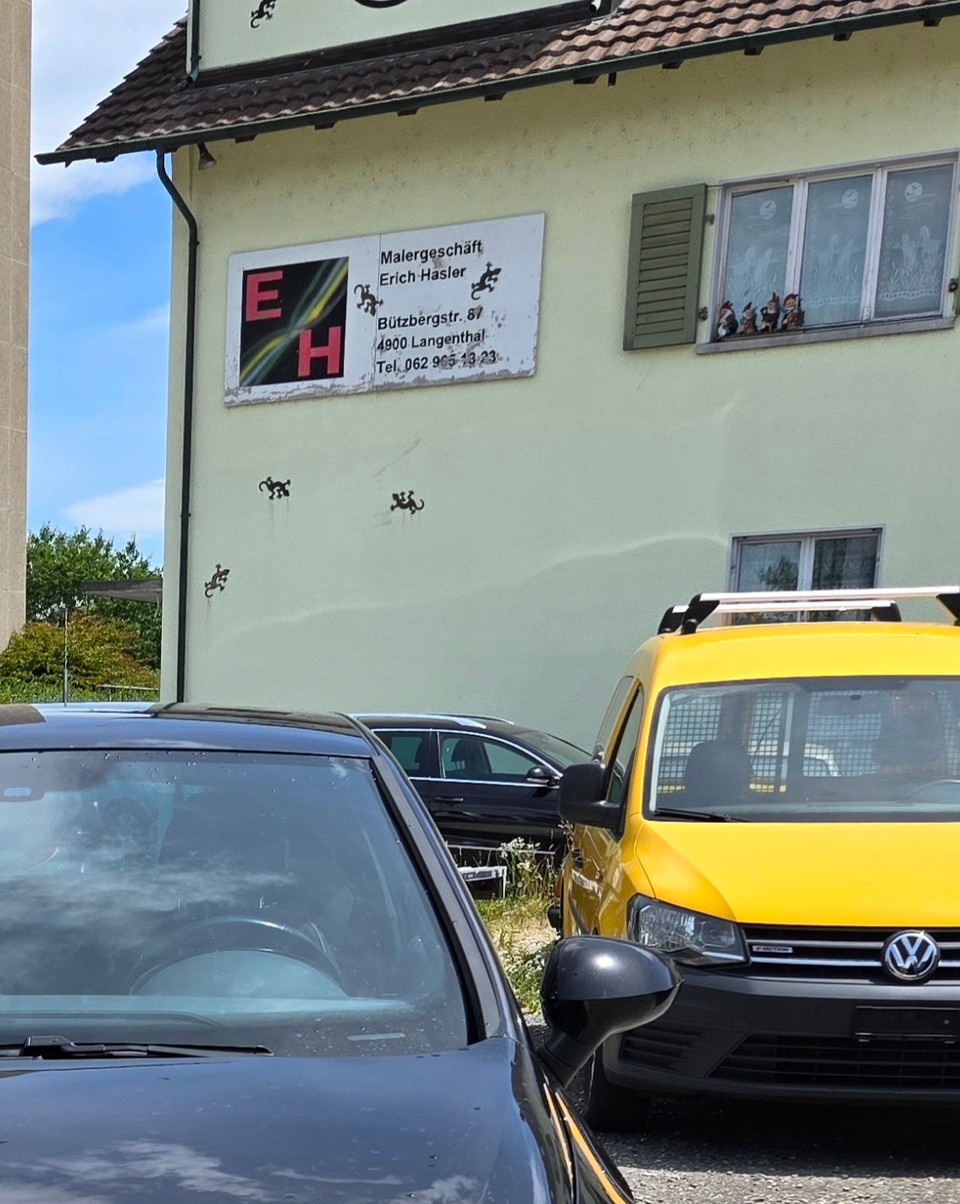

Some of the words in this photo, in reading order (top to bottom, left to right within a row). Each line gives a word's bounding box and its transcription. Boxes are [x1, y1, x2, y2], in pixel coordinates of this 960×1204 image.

[380, 239, 483, 265] Malergeschäft
[379, 269, 416, 287] Erich
[420, 265, 467, 282] Hasler
[245, 270, 284, 322] E
[377, 310, 463, 331] Bützbergstr.
[376, 336, 408, 351] 4900
[411, 328, 486, 349] Langenthal
[297, 326, 342, 379] H
[376, 359, 401, 374] Tel.
[404, 356, 429, 372] 062
